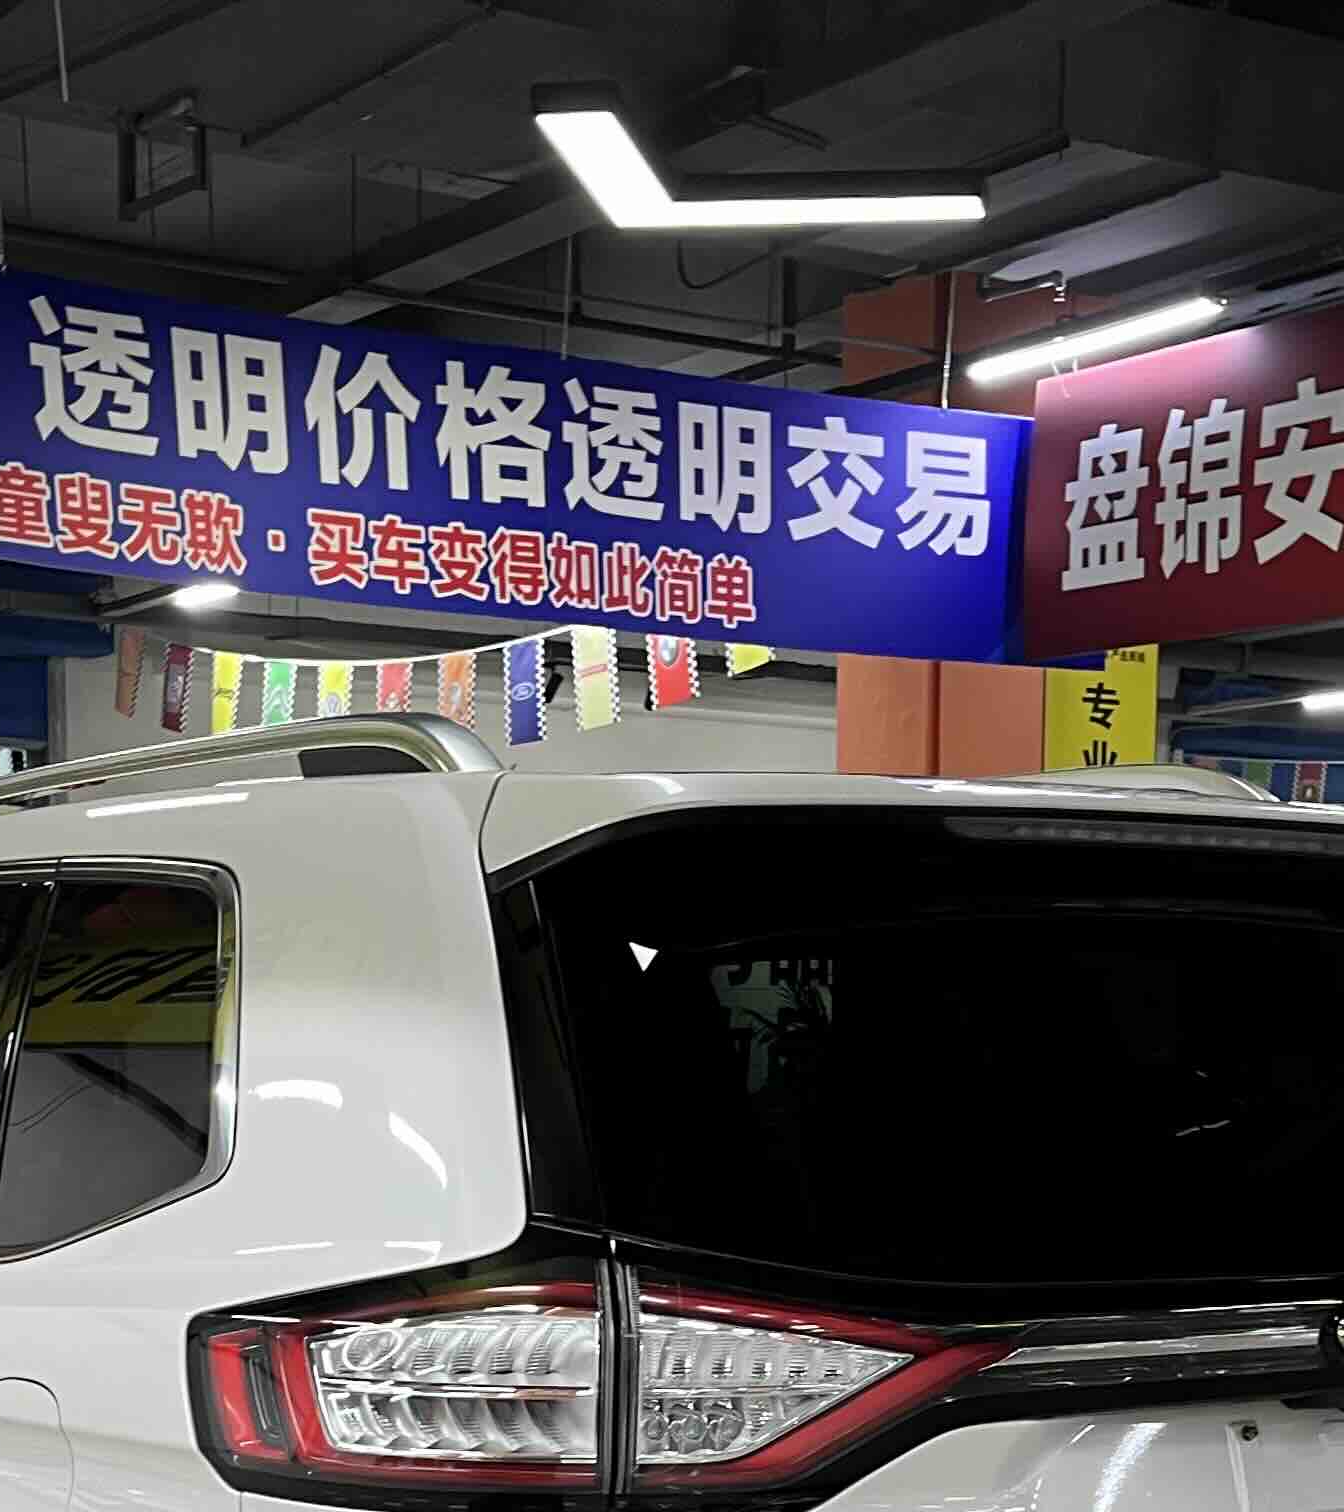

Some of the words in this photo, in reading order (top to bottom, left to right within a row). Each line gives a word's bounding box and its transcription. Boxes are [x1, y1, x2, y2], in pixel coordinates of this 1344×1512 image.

[29, 294, 991, 557] 透明价格透明交易
